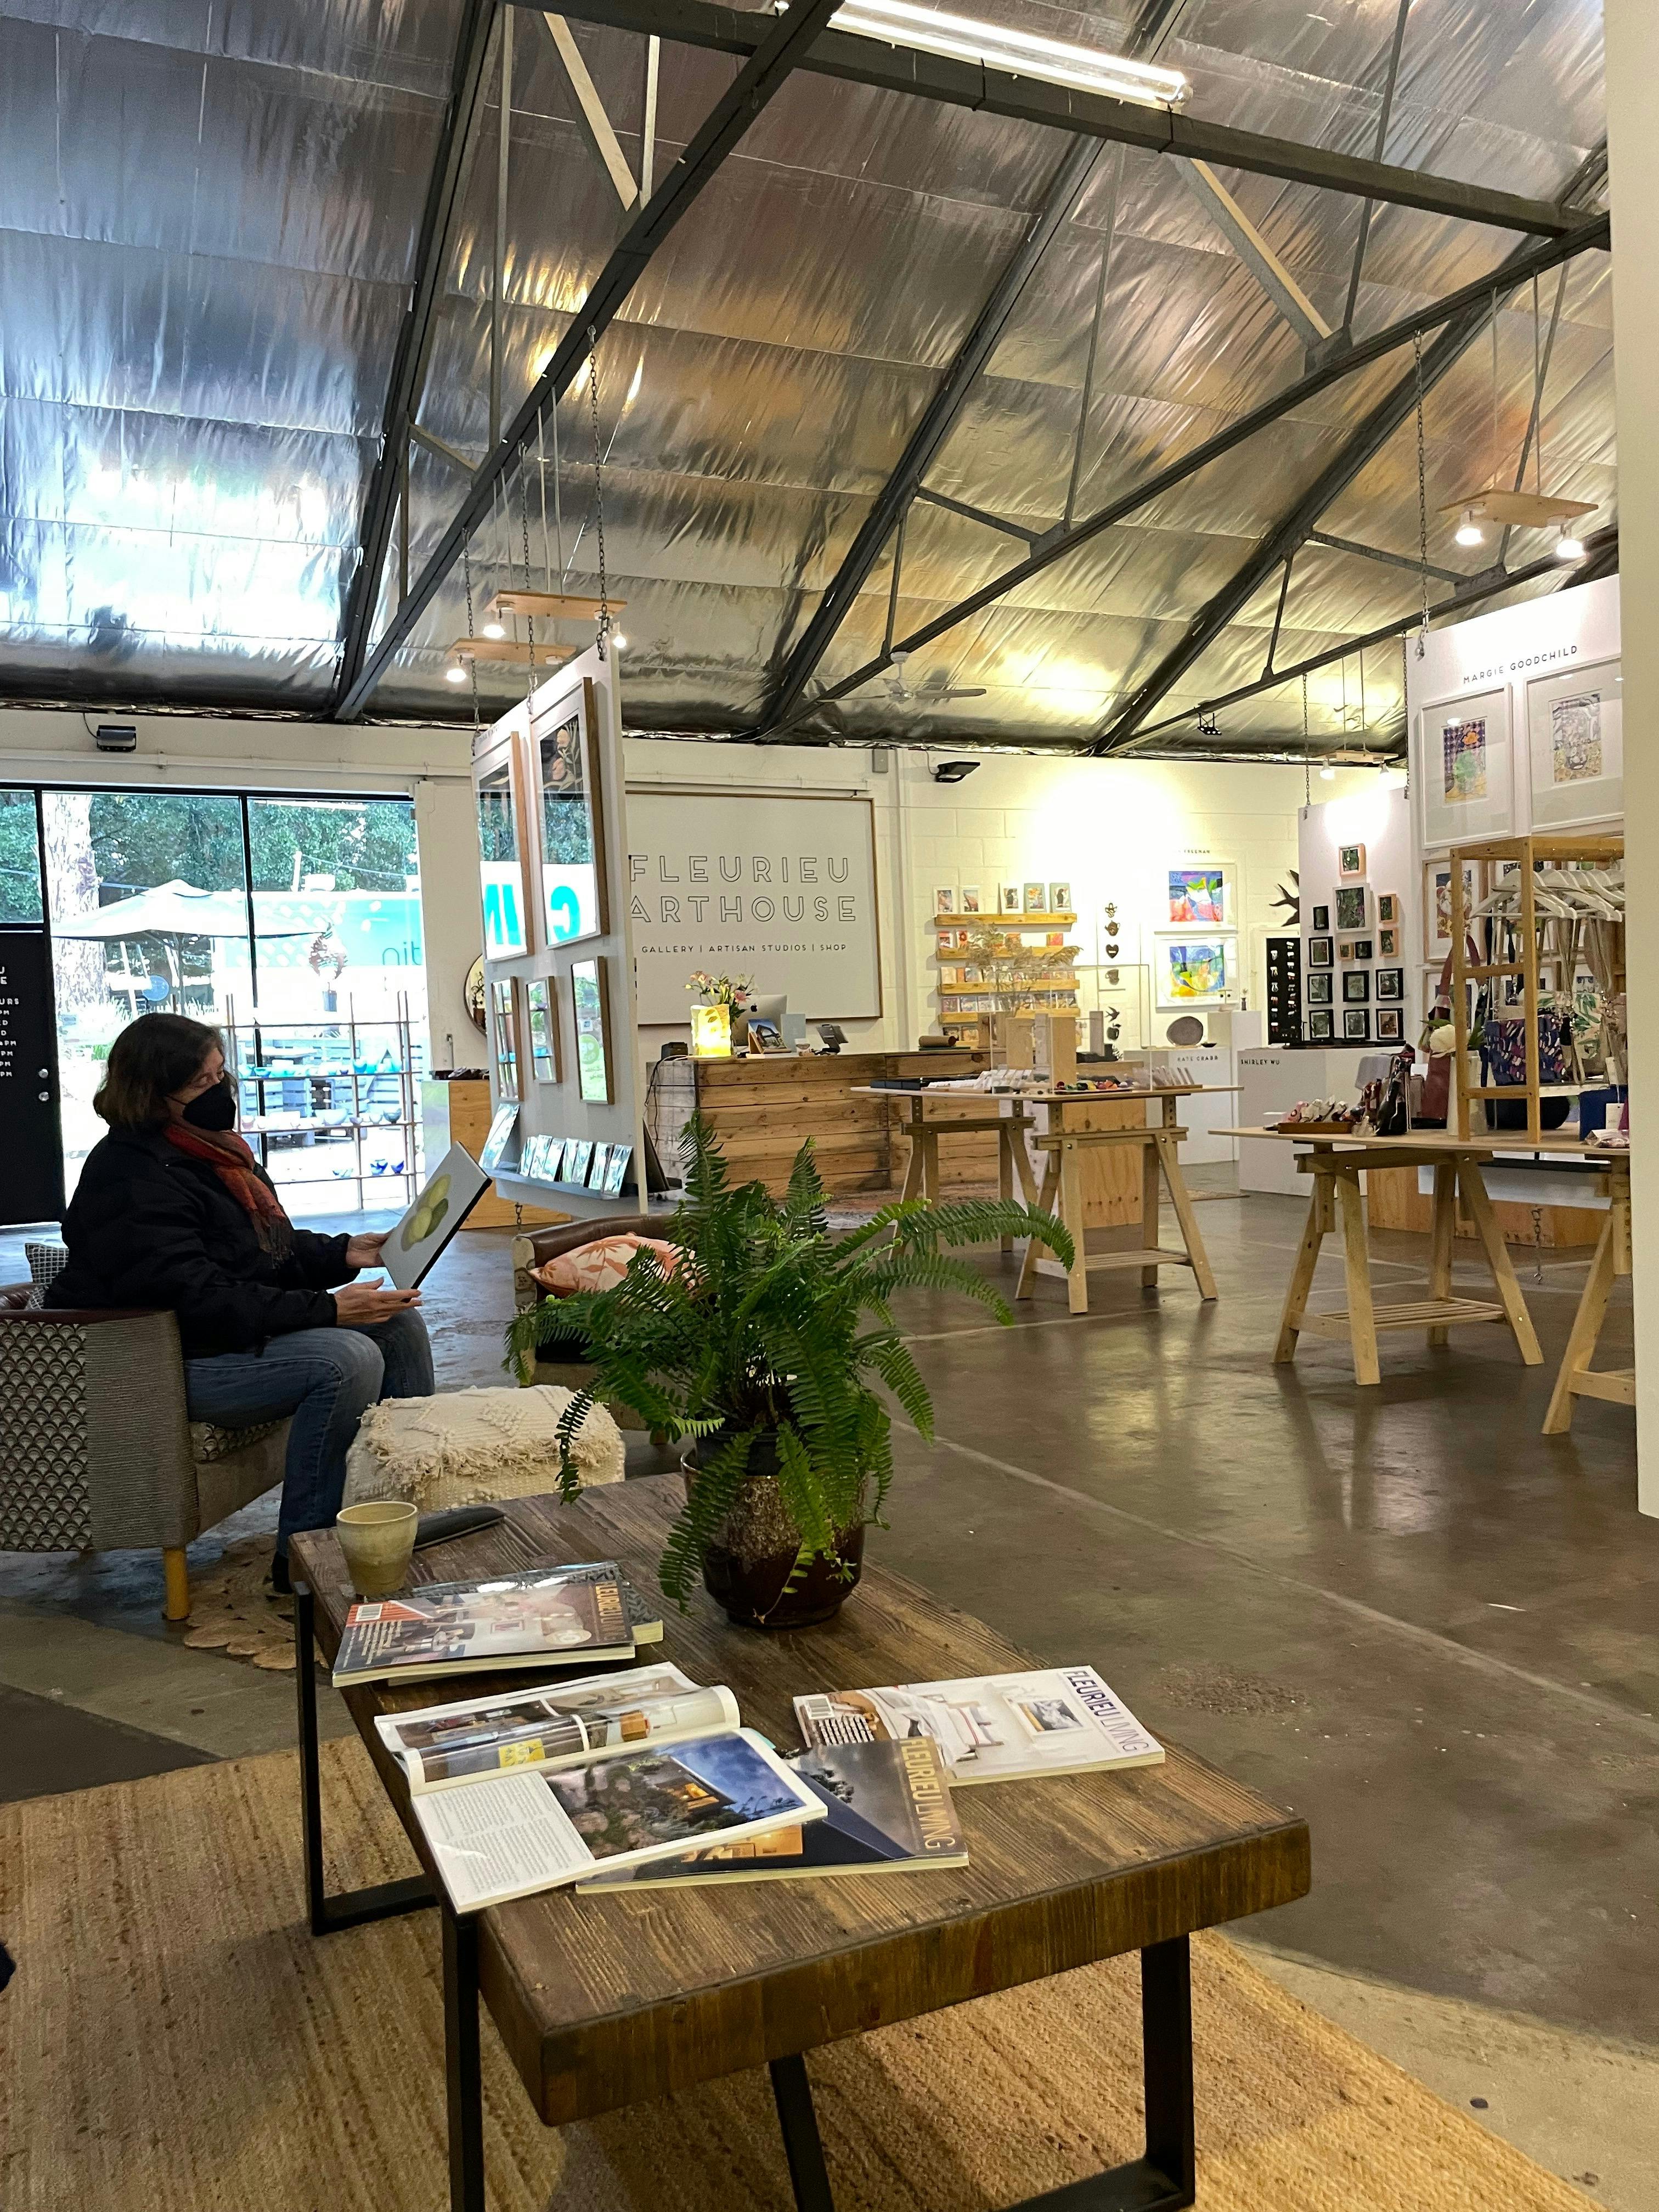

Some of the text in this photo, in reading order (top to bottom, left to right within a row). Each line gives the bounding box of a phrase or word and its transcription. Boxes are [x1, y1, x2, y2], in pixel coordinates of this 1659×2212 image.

[1463, 646, 1577, 684] MARGIE GOODCHILD
[630, 855, 849, 883] FLEURIEU
[630, 895, 856, 923] ARTHOUSE
[641, 945, 694, 953] GALLERY
[761, 944, 807, 952] STUDIOS
[1062, 1670, 1150, 1752] FLEURIEU LIVING
[899, 1738, 956, 1849] FLEURIEU LIVING
